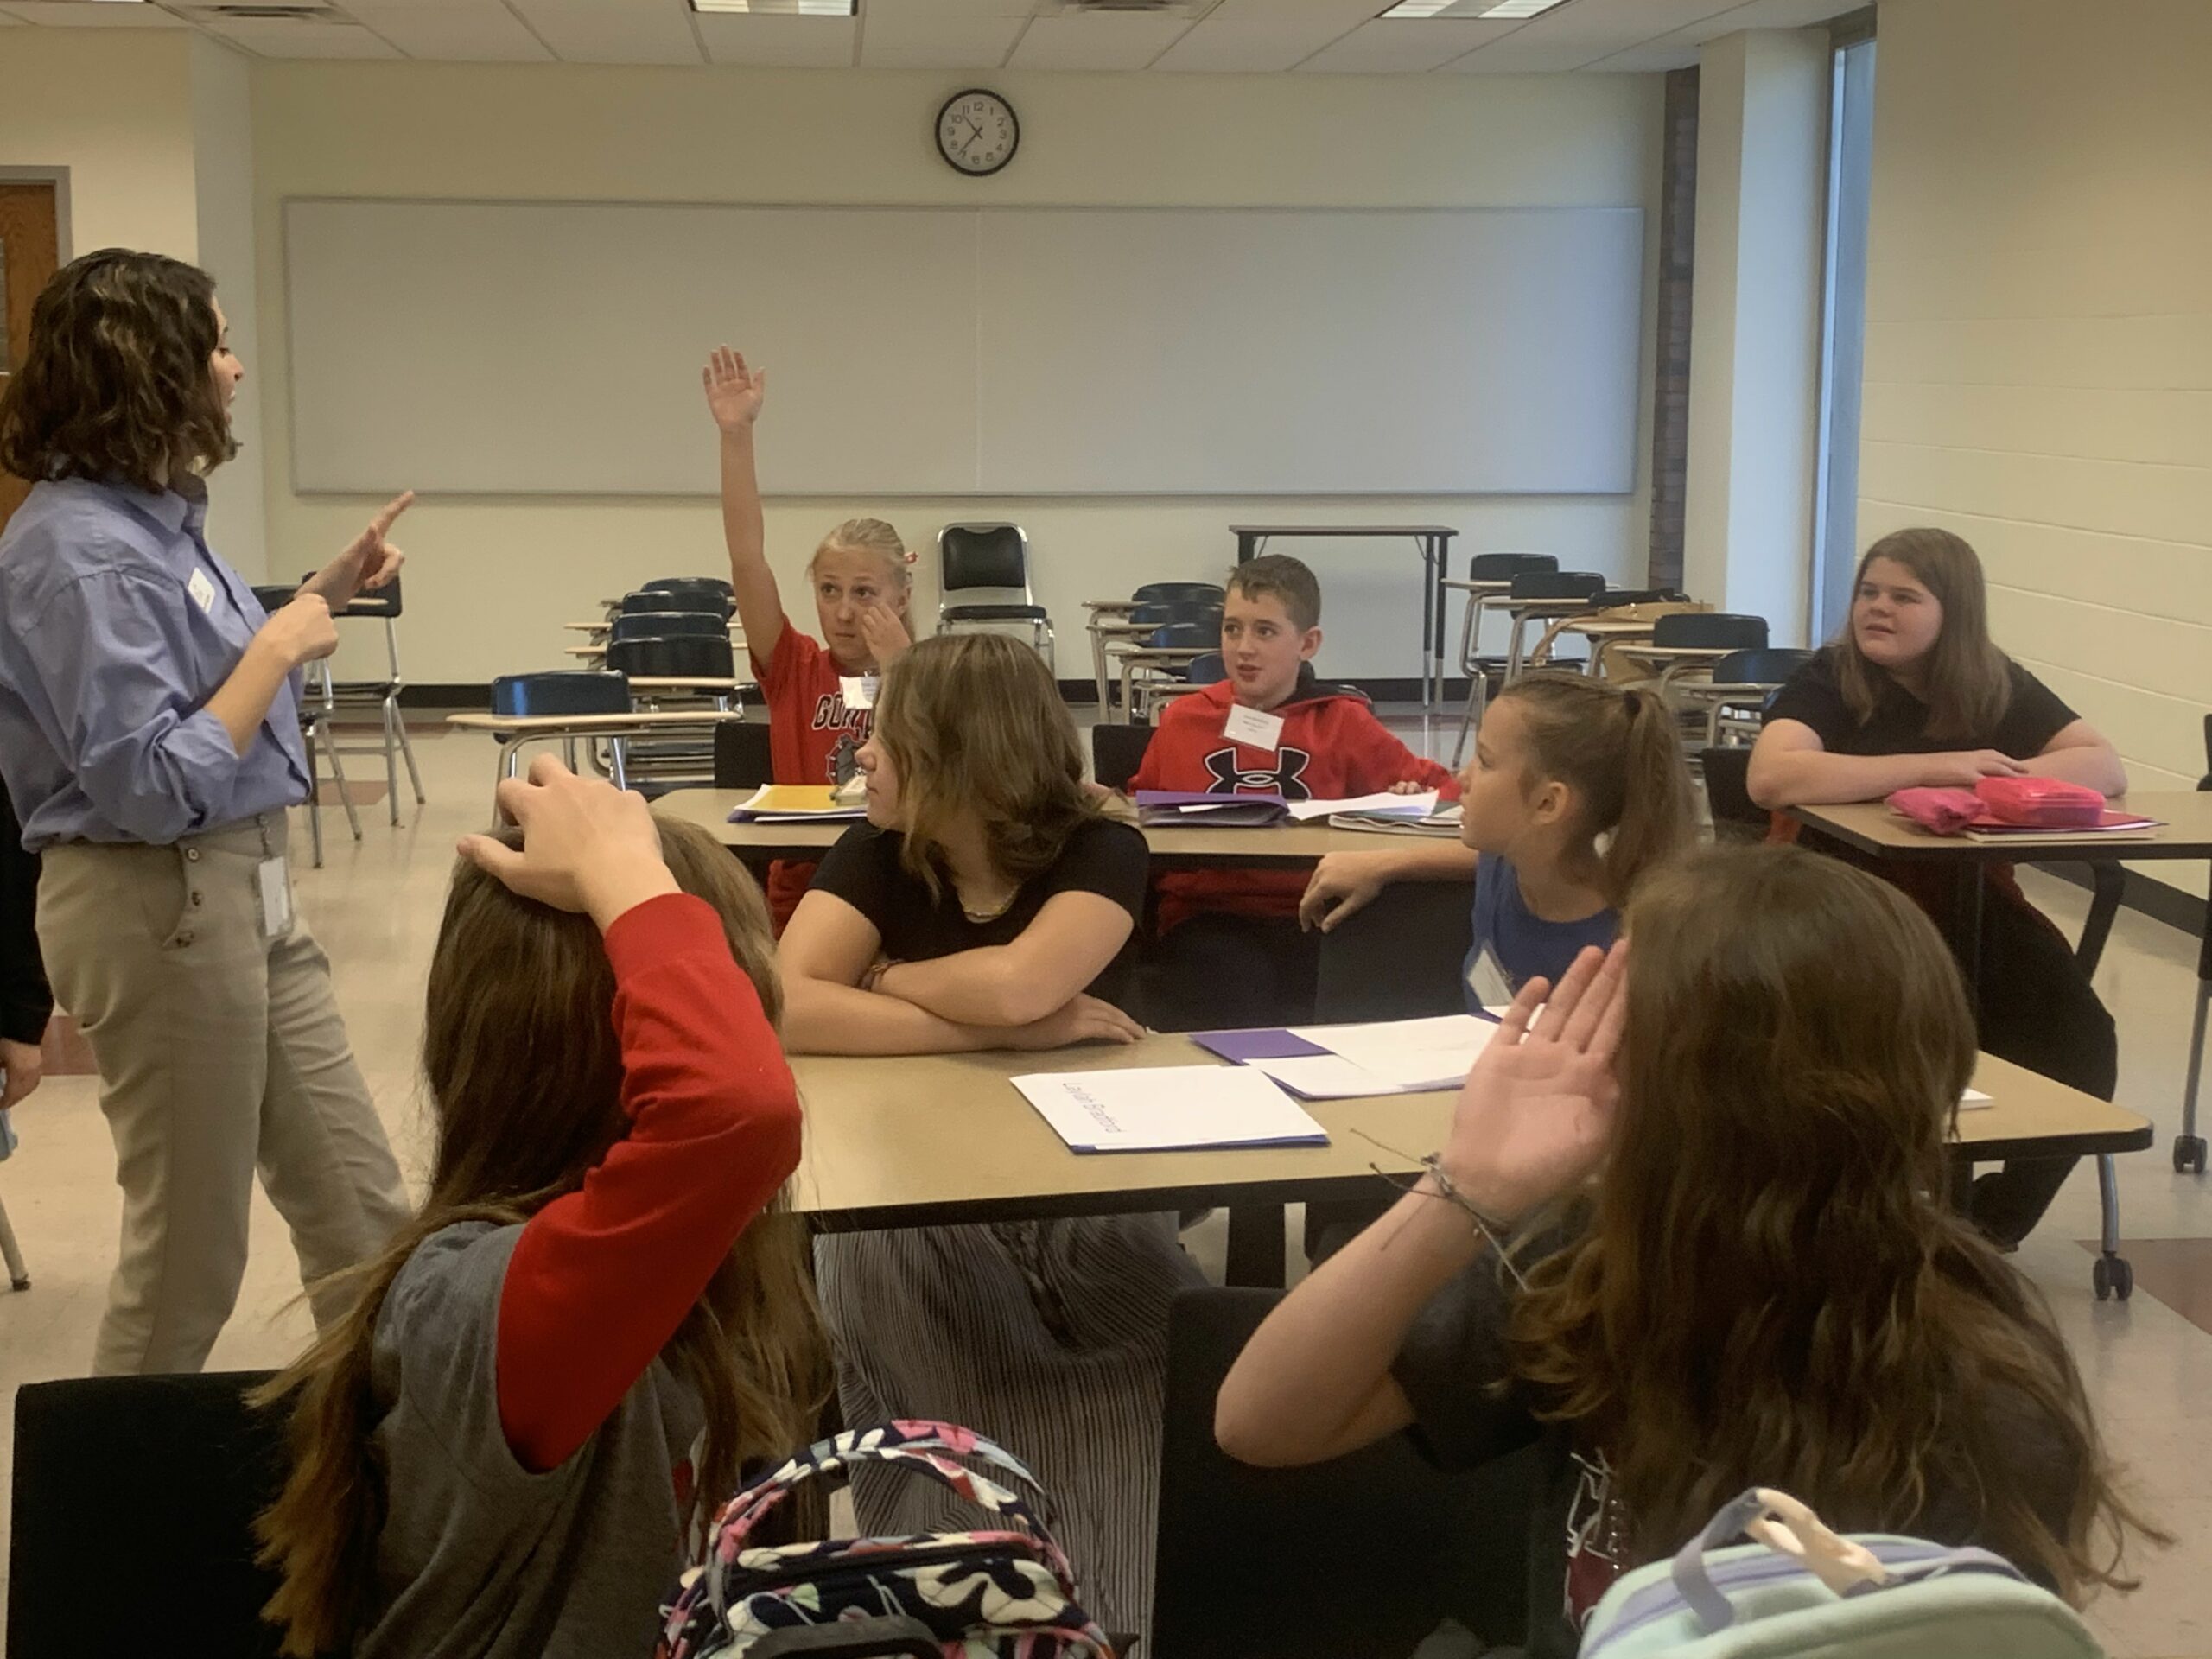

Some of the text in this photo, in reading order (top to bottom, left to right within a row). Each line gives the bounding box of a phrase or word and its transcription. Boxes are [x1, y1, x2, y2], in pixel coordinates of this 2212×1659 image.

[962, 105, 970, 114] 11
[974, 101, 984, 111] 12
[990, 107, 995, 116] 1
[951, 114, 963, 124] 10
[996, 117, 1005, 127] 2
[947, 126, 956, 136] 9
[999, 130, 1007, 139] 3
[950, 140, 958, 149] 8
[996, 143, 1003, 152] 4
[971, 155, 980, 165] 6
[985, 152, 995, 162] 5
